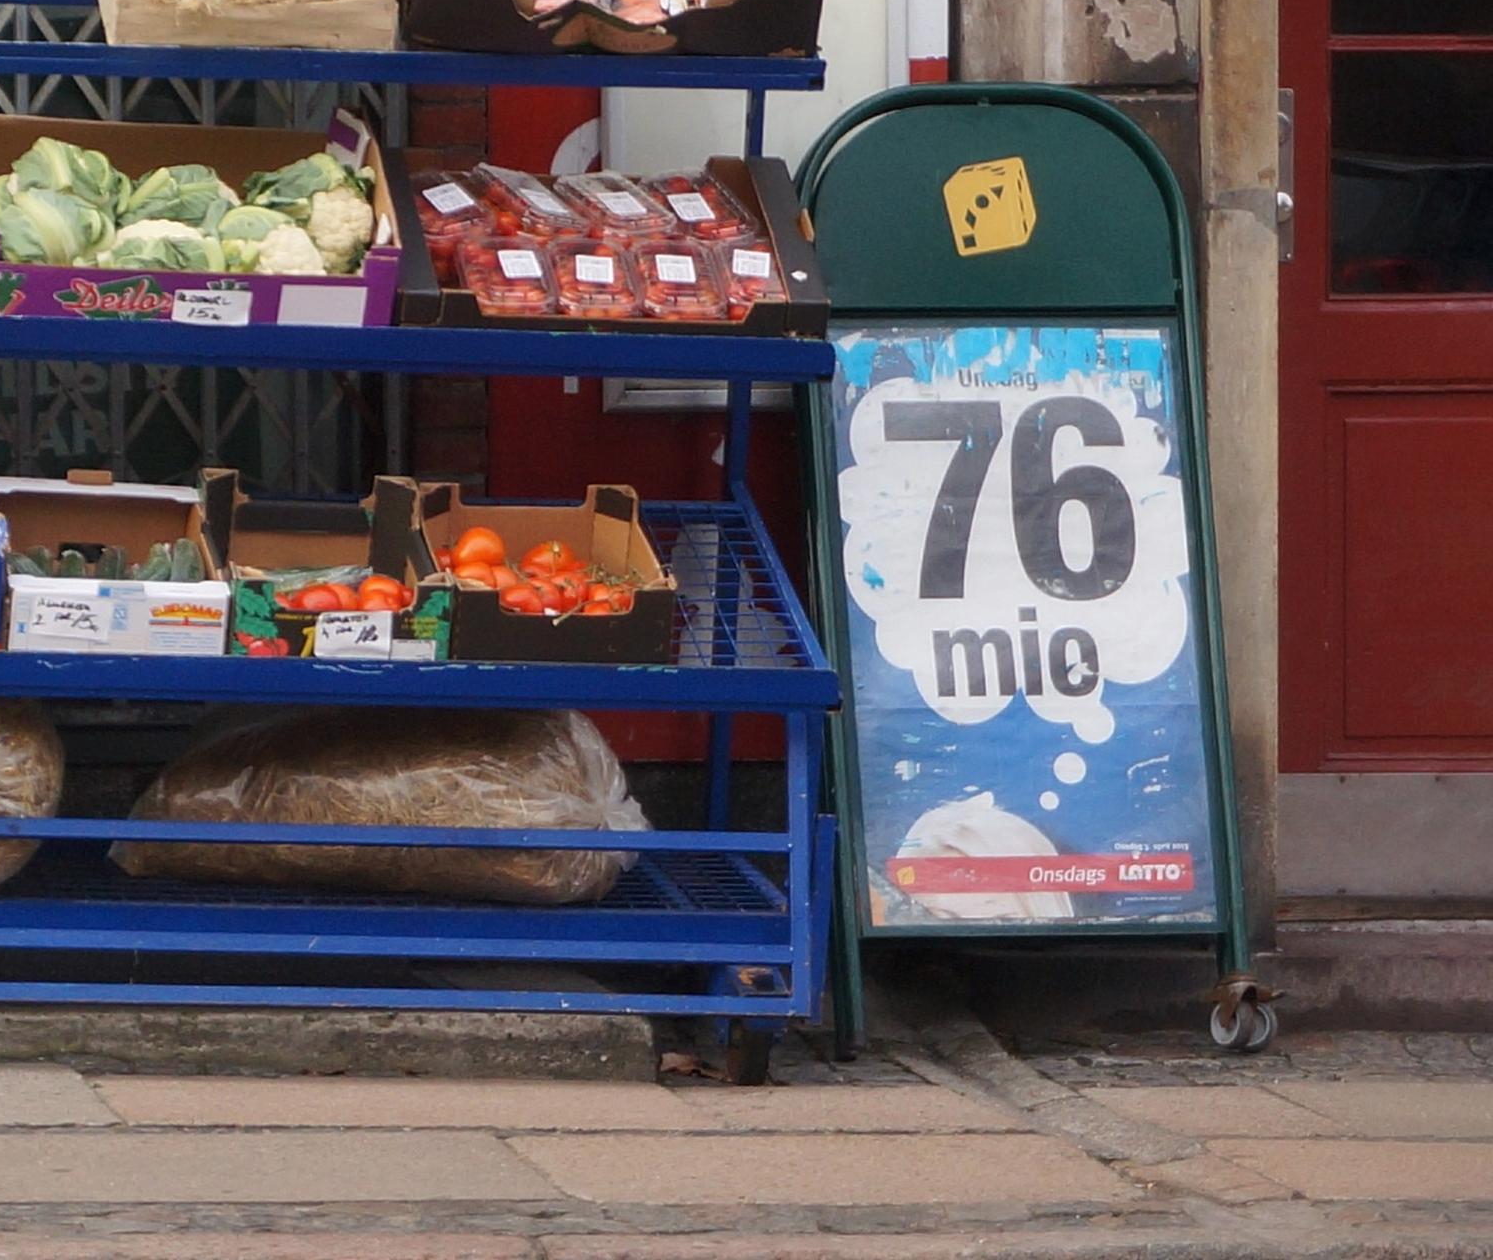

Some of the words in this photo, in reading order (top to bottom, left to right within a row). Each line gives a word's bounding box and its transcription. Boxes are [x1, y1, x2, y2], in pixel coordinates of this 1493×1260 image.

[883, 396, 1135, 601] 76
[932, 607, 1100, 699] mio
[1029, 865, 1107, 885] Onsdags
